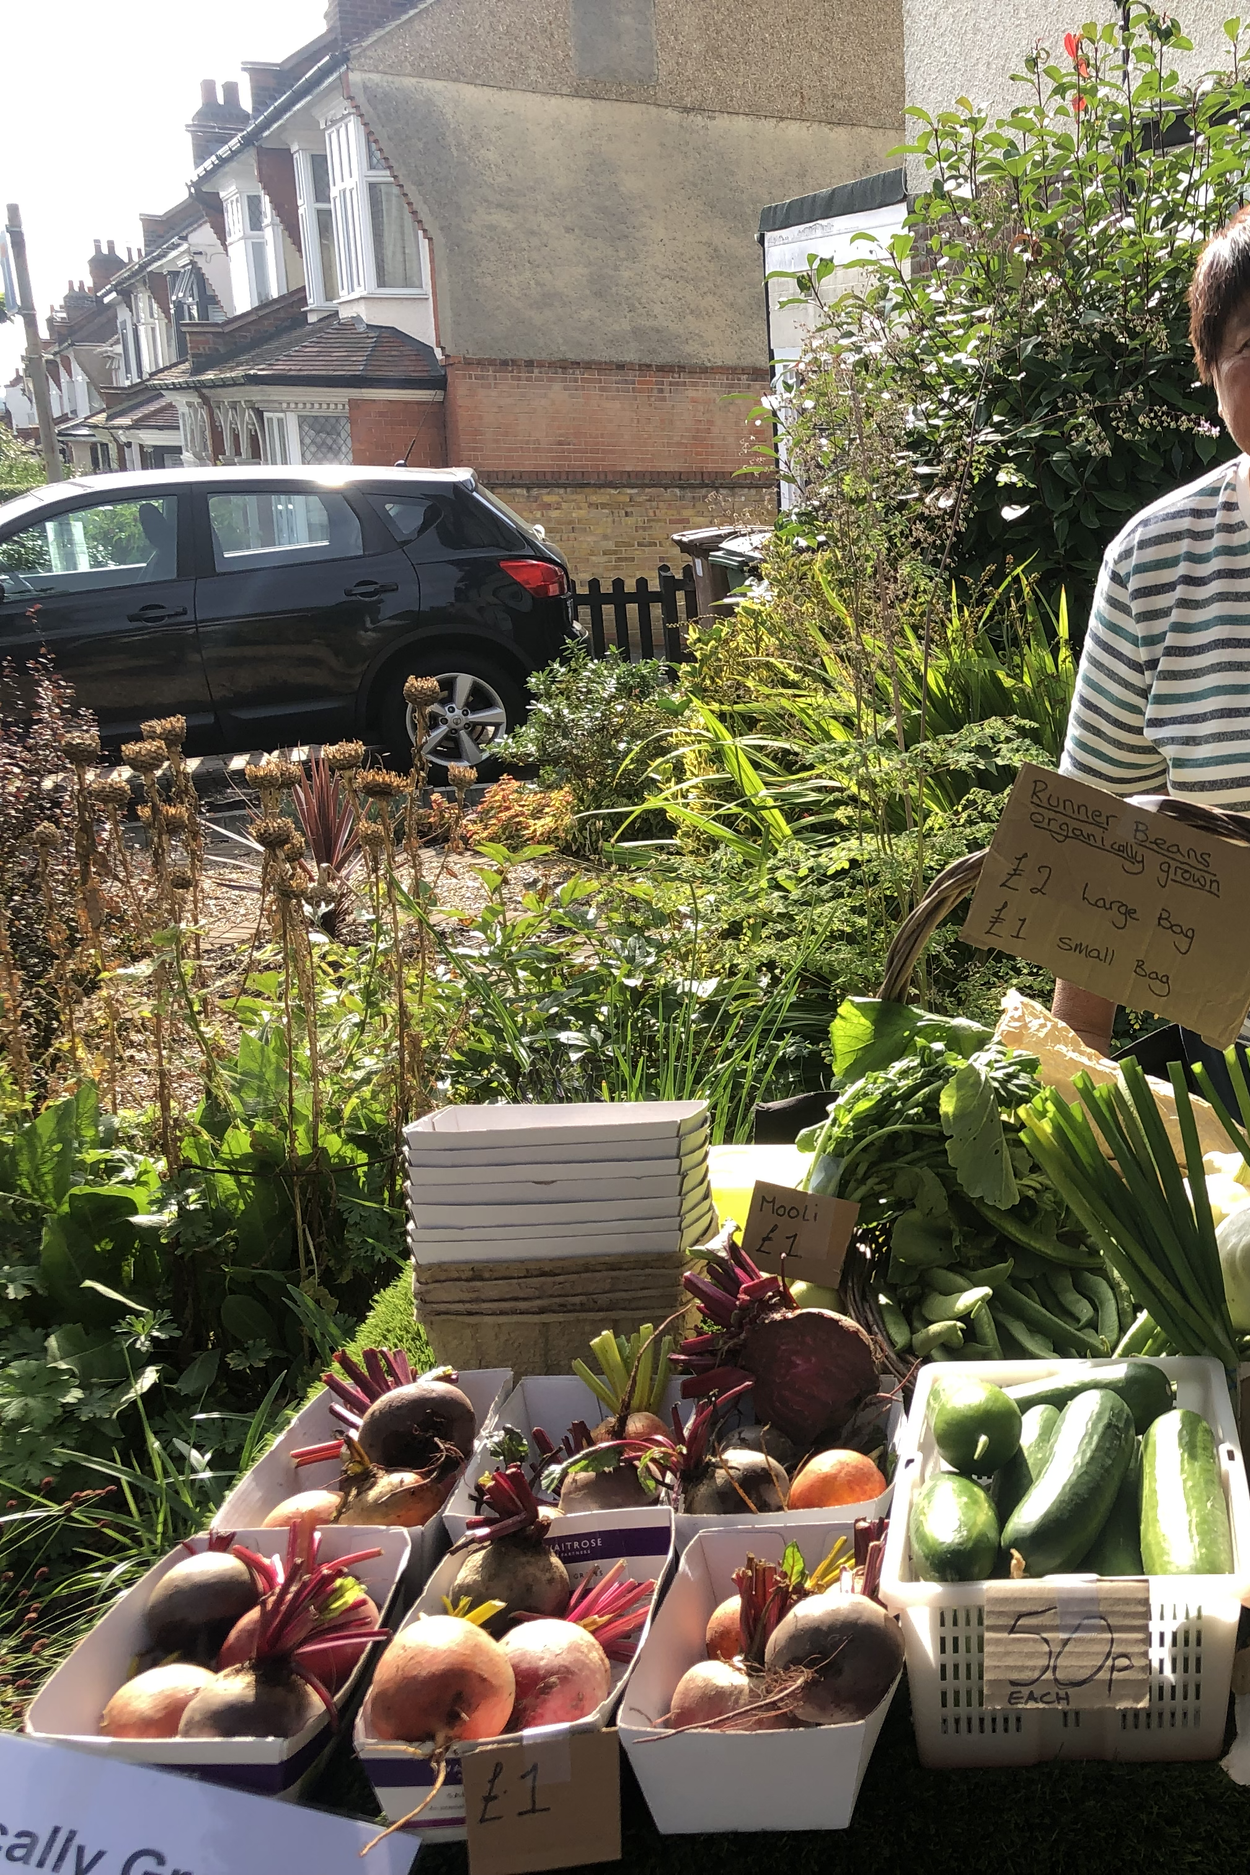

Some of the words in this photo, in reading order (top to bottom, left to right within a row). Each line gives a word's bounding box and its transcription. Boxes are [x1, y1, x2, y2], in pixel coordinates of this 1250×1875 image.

[1029, 811, 1145, 876] organically
[1156, 861, 1221, 893] grown
[1031, 779, 1119, 827] Runner
[1133, 820, 1213, 869] Beans
[999, 853, 1052, 896] £2
[1082, 882, 1140, 930] Large
[1157, 908, 1196, 955] Bag
[984, 901, 1027, 941] £1
[1133, 959, 1171, 998] Bag
[755, 1224, 803, 1259] £1
[550, 1537, 603, 1552] AITROSE
[1007, 1605, 1135, 1699] 50p
[1008, 1690, 1070, 1706] EACH
[0, 1822, 109, 1875] ally
